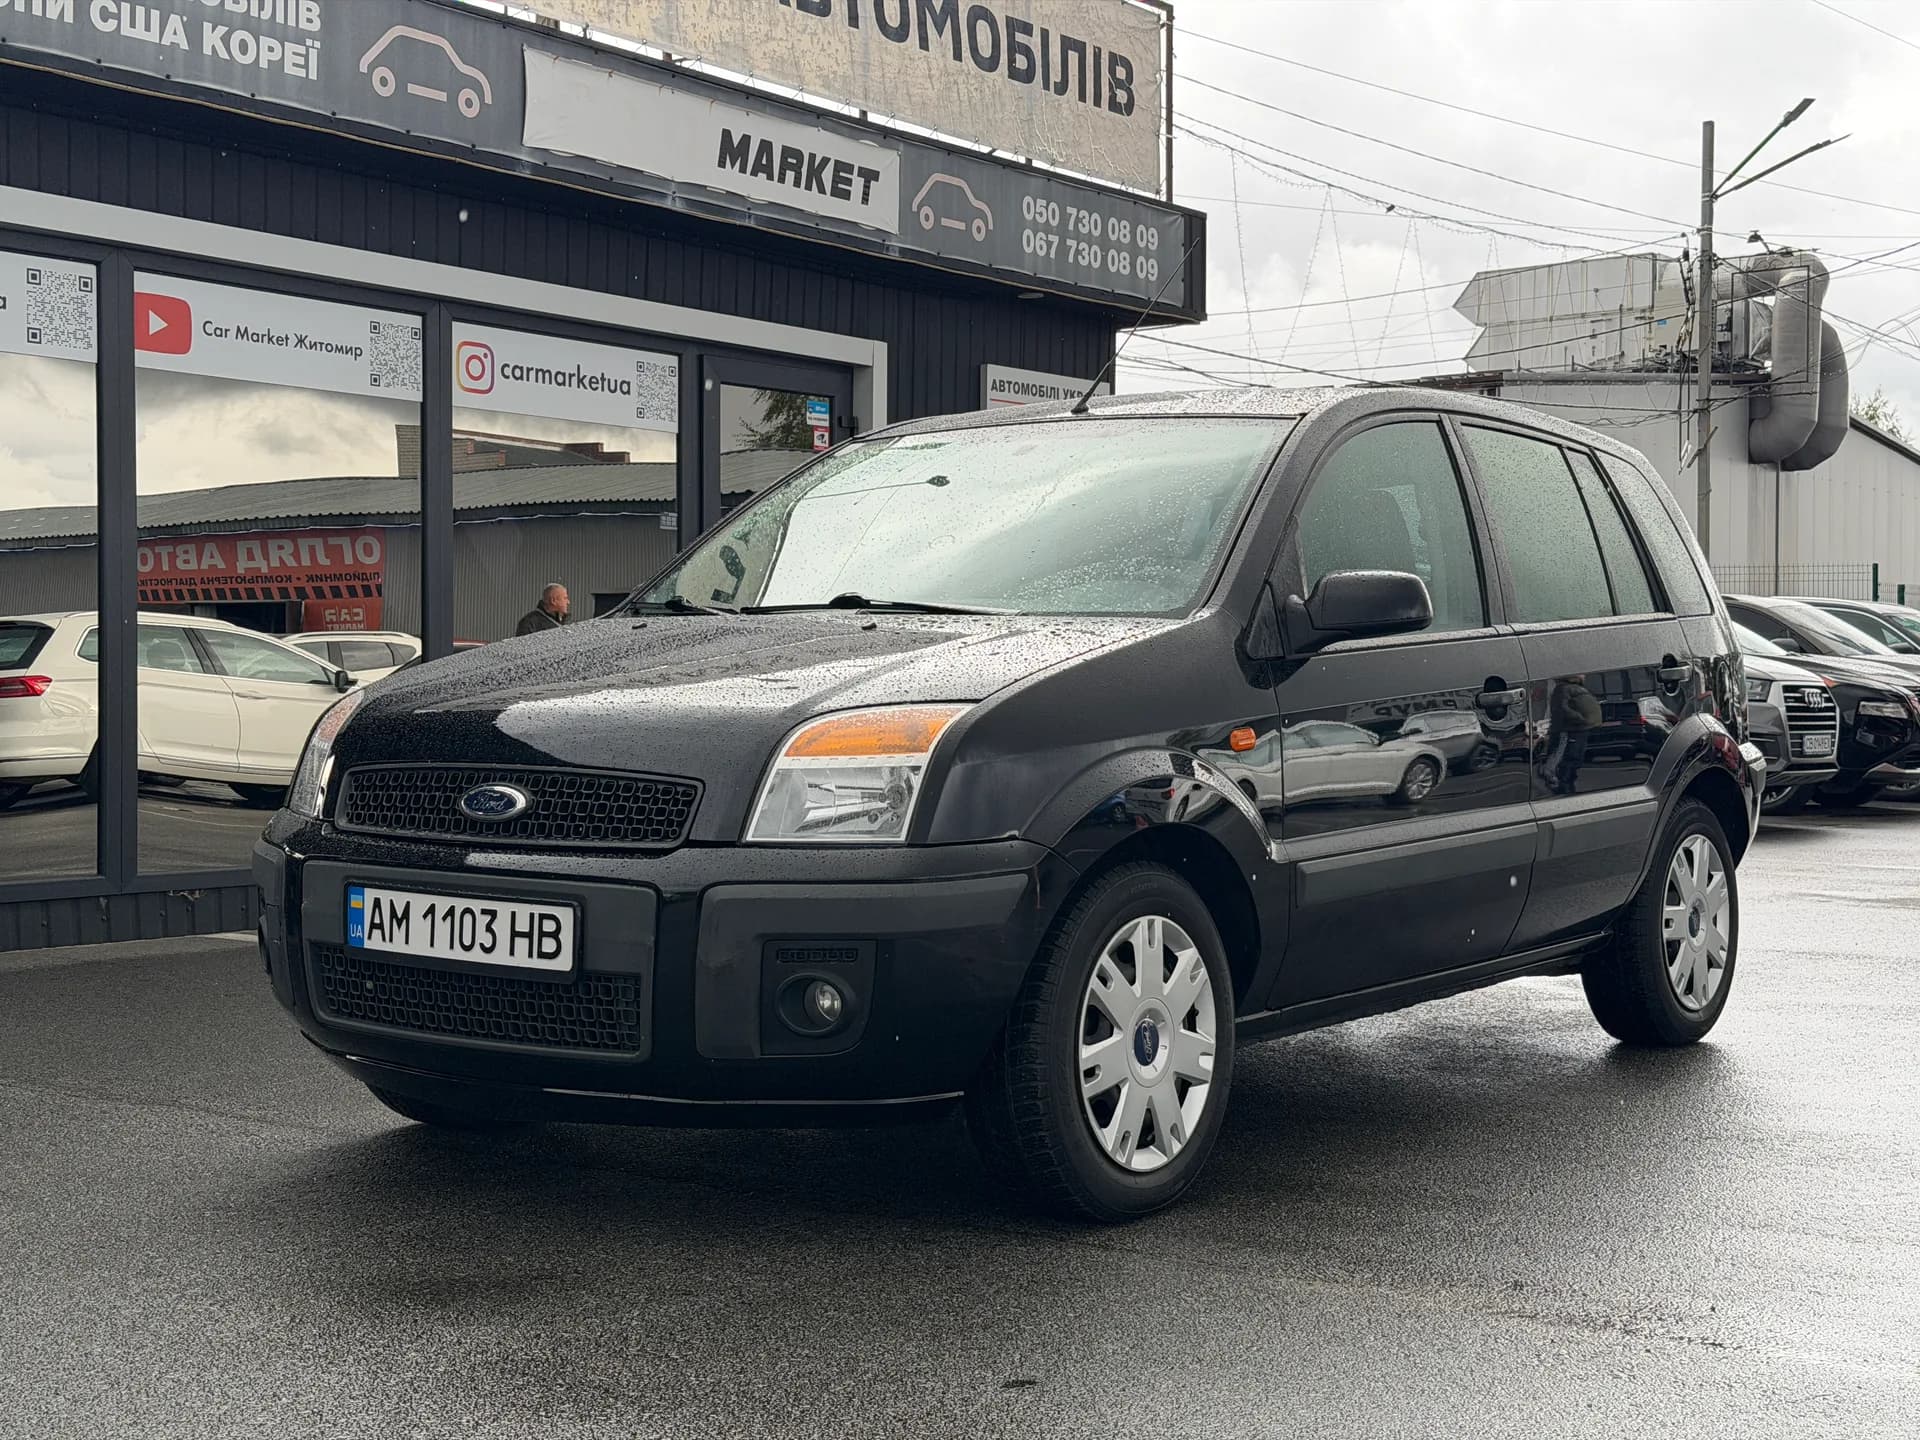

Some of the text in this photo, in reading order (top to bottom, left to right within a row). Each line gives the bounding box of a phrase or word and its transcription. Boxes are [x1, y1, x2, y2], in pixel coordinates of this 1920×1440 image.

[89, 0, 190, 50] США
[202, 21, 321, 80] КОРЕЇ
[717, 128, 880, 206] MARKET
[1022, 195, 1159, 251] 050 730 08 09
[1022, 229, 1159, 282] 067 730 08 09
[202, 320, 364, 361] Car Market Житомир
[500, 362, 632, 396] carmarketua
[990, 379, 1060, 401] АВТОМОБІЛІ
[350, 923, 363, 938] UA
[367, 897, 562, 960] AM 1103 HB
